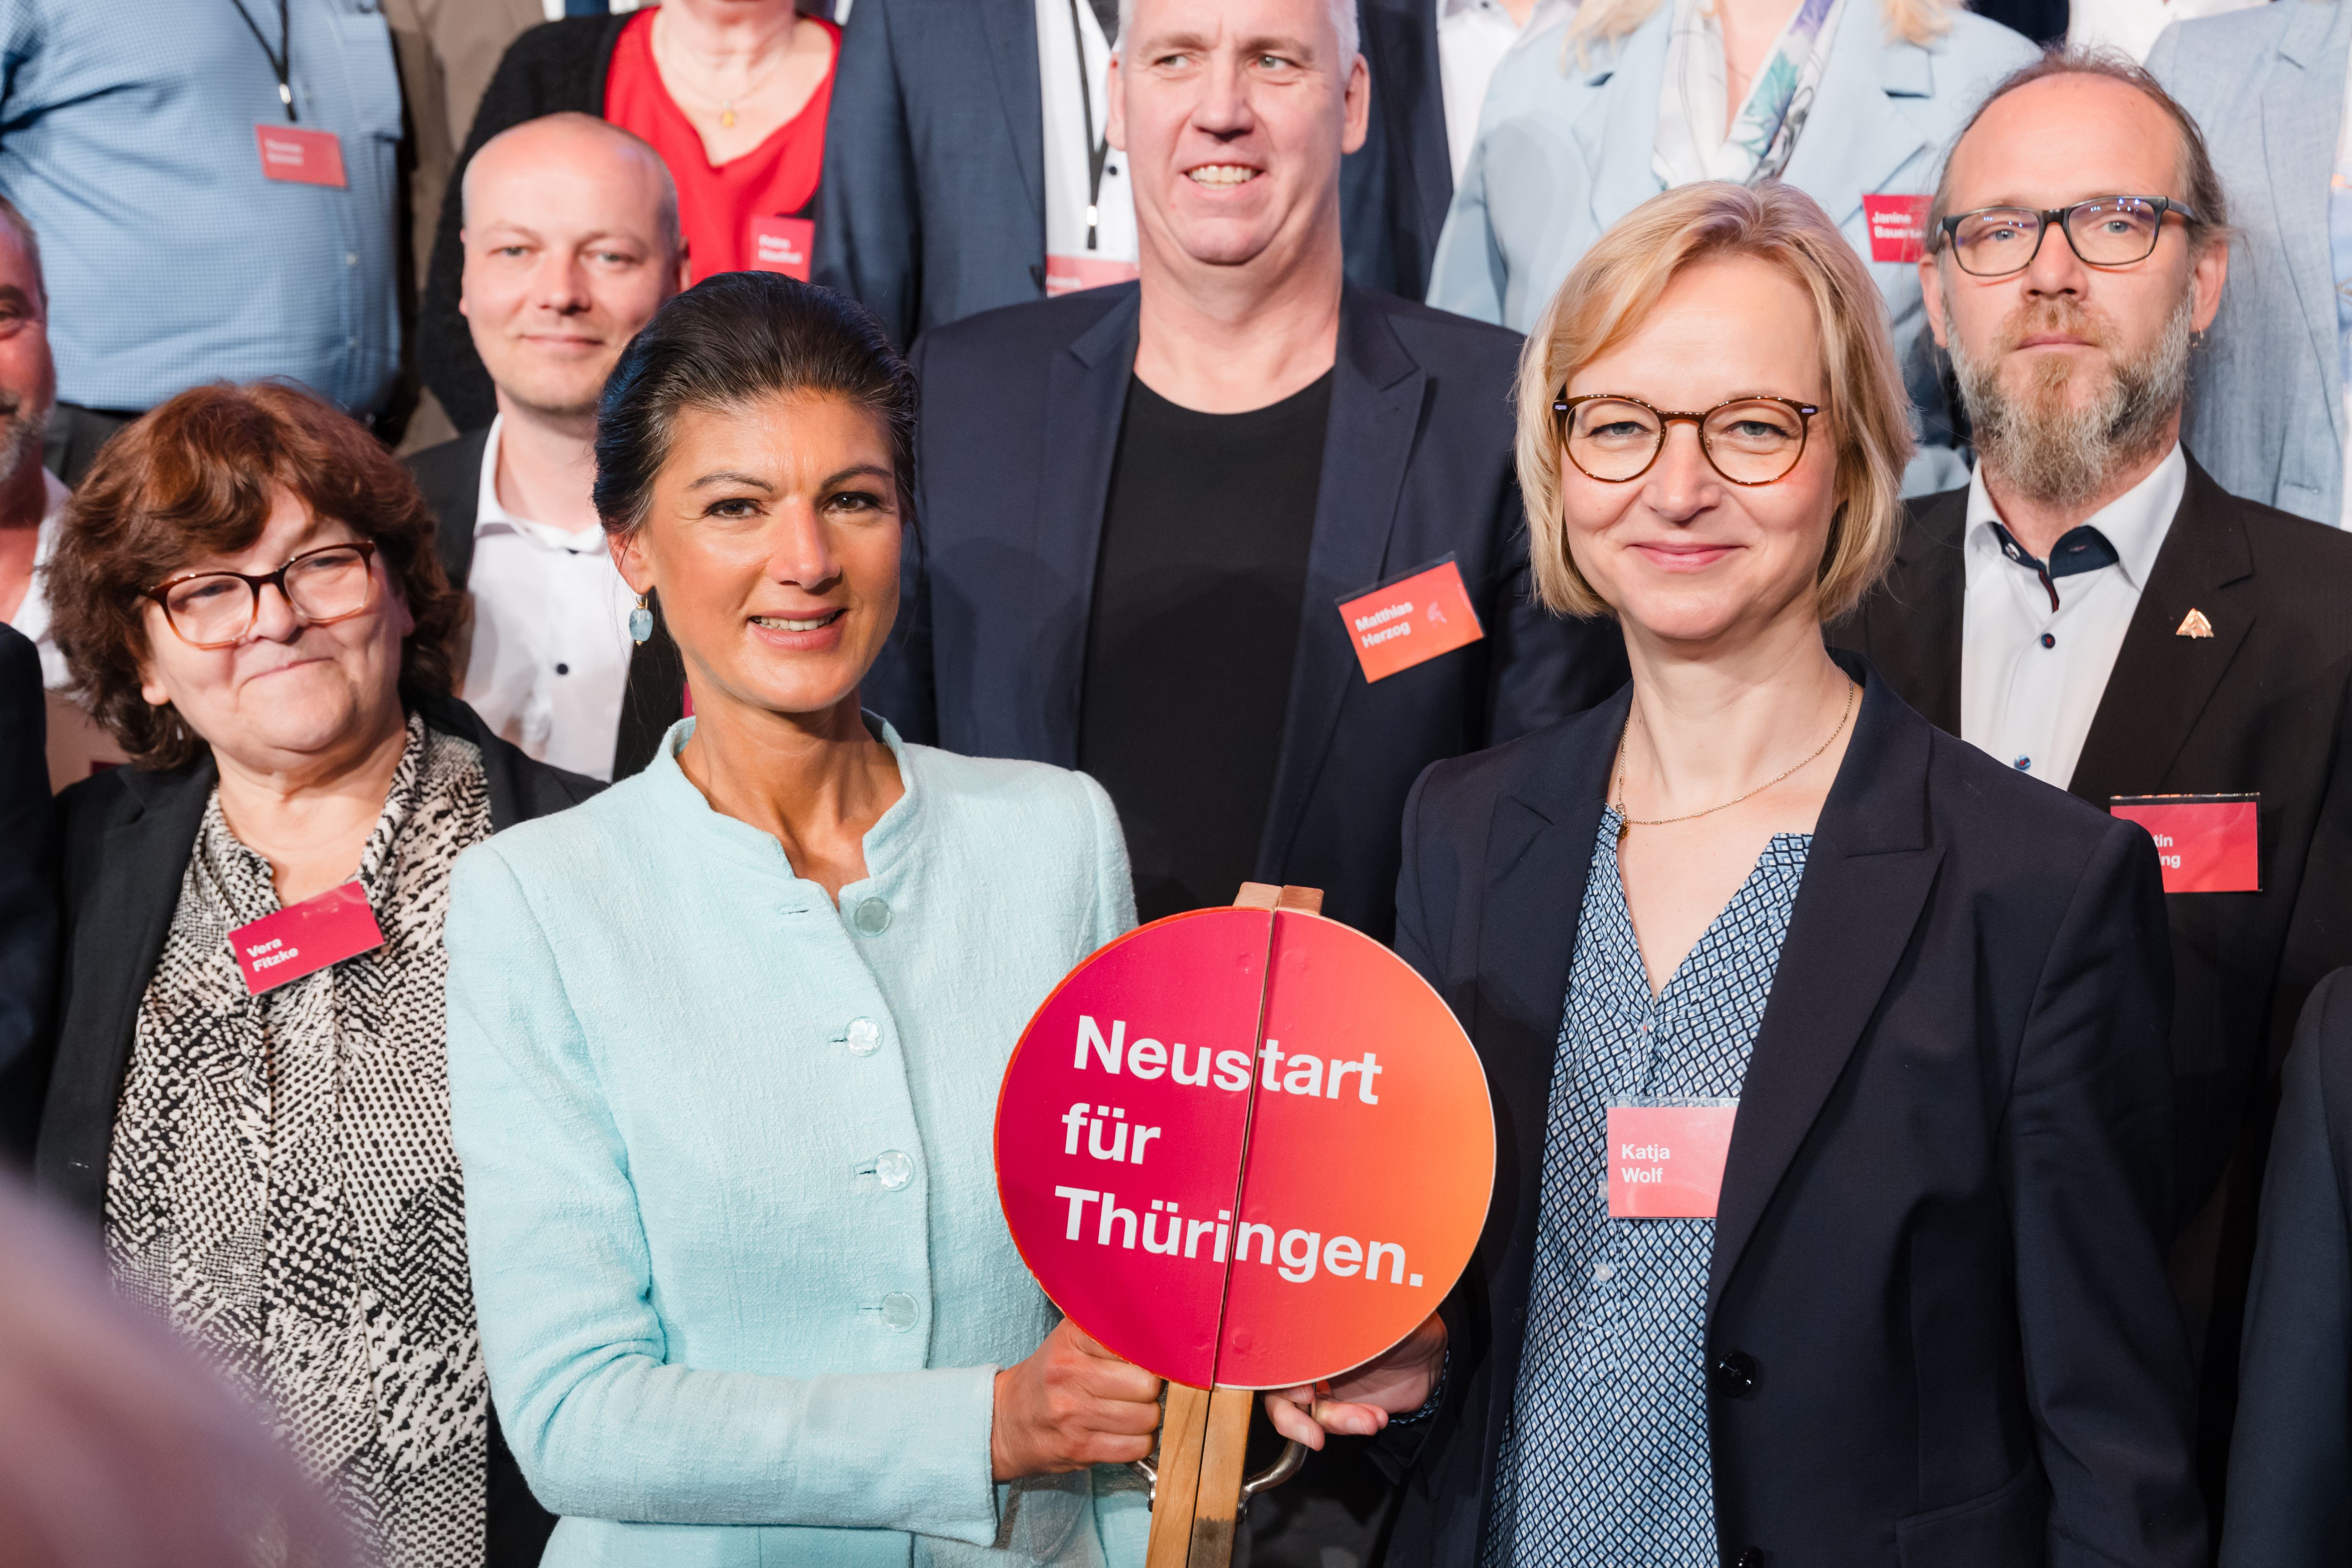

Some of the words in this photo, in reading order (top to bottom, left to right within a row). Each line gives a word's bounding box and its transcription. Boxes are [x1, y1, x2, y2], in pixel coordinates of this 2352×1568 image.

[1355, 602, 1414, 632] Matthias
[1361, 621, 1411, 649] Herzog
[246, 938, 283, 958] Vera
[252, 948, 299, 972] Fitzke
[1073, 1015, 1383, 1105] Neustart
[1061, 1102, 1161, 1164] für
[1621, 1143, 1670, 1163] Katja
[1621, 1167, 1664, 1183] Wolf
[1055, 1185, 1423, 1287] Thüringen.
